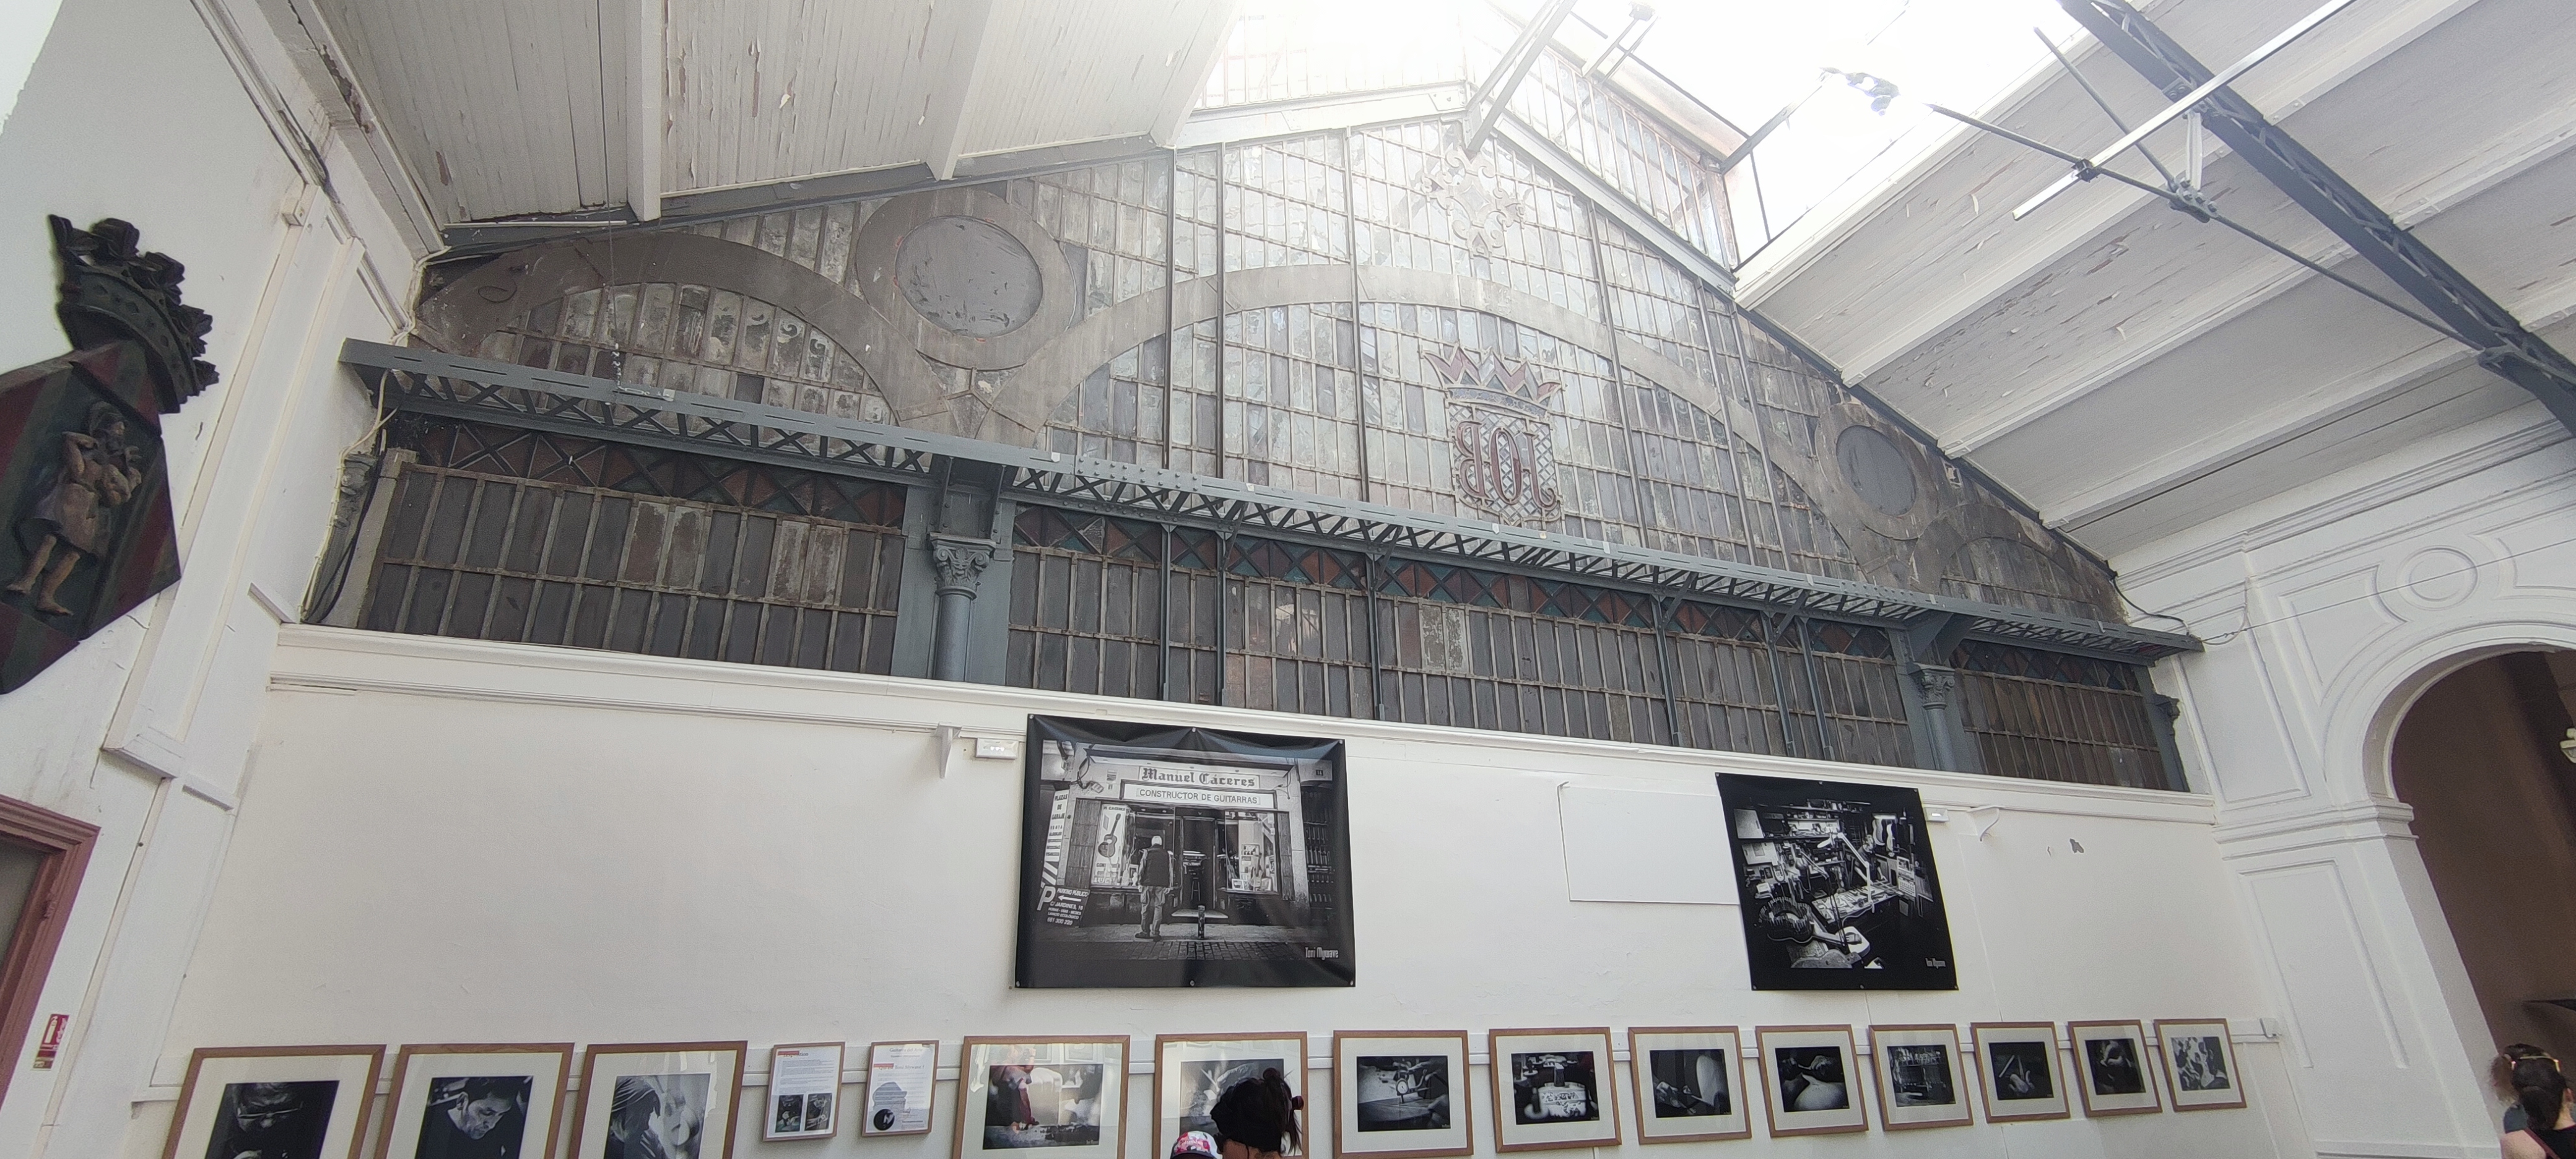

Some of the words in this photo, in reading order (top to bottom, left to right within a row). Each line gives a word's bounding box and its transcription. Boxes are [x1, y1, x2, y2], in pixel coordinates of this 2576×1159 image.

[1141, 767, 1194, 783] Manuel
[1199, 773, 1255, 788] Cáceres
[1139, 789, 1198, 801] CONSTRUCTOR
[1201, 793, 1211, 801] DE
[1214, 794, 1257, 804] GUITARRAS
[1305, 947, 1316, 958] Toni
